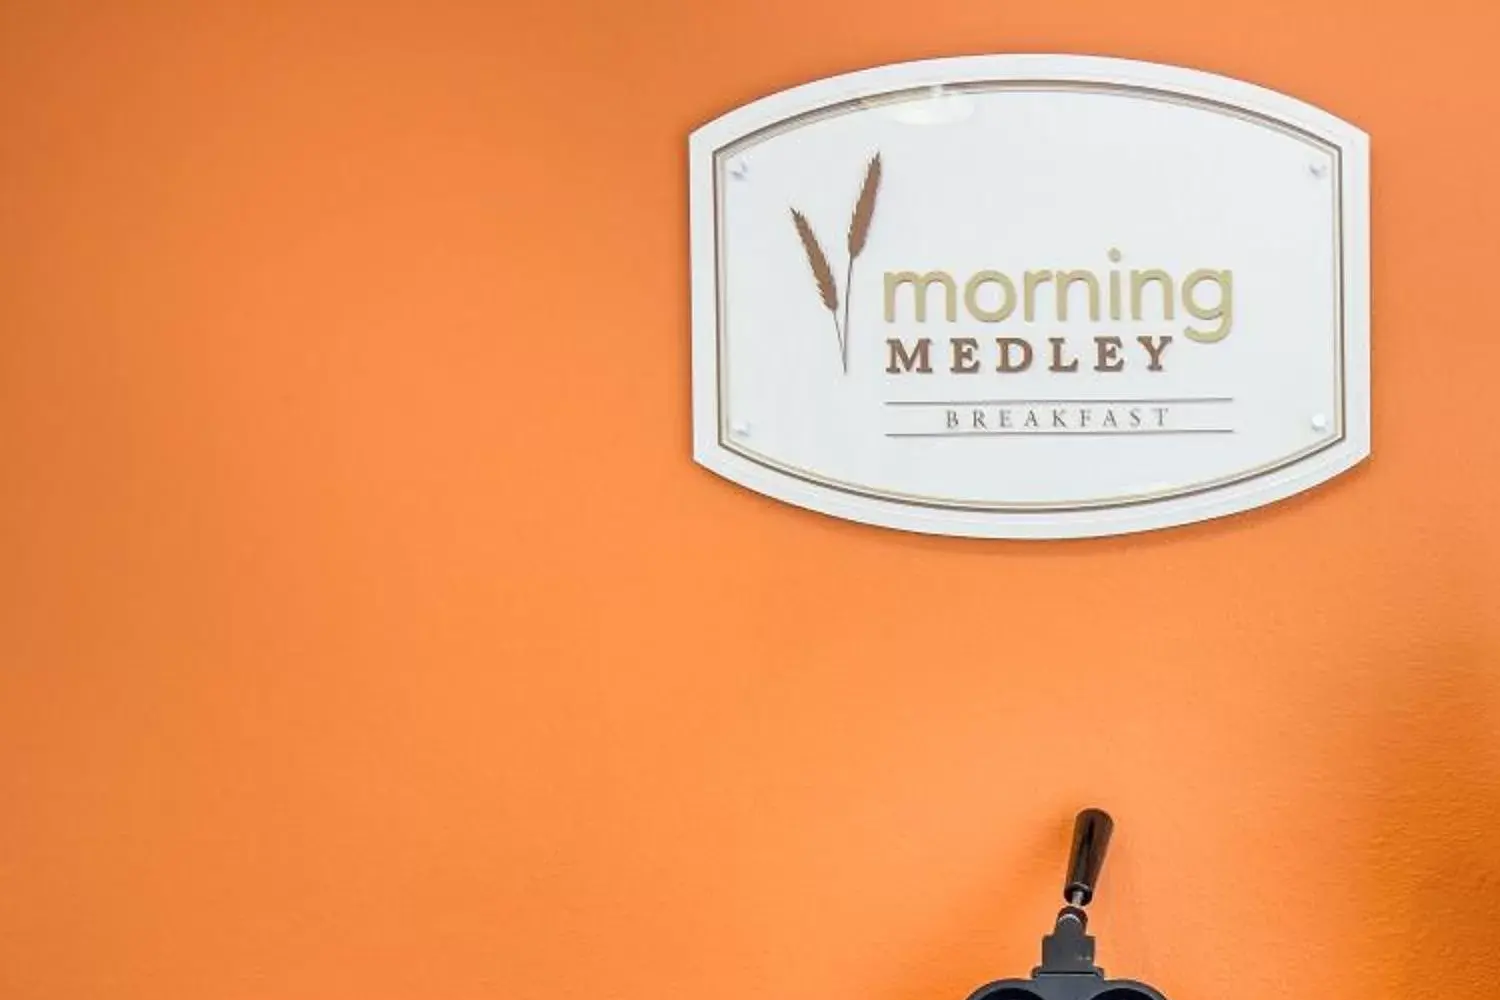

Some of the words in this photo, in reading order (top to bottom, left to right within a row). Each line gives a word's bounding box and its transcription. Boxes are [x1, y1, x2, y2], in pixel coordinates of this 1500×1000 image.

[883, 247, 1233, 343] morning
[885, 336, 1173, 374] MEDLEY
[945, 407, 1171, 429] BREAKFAST
